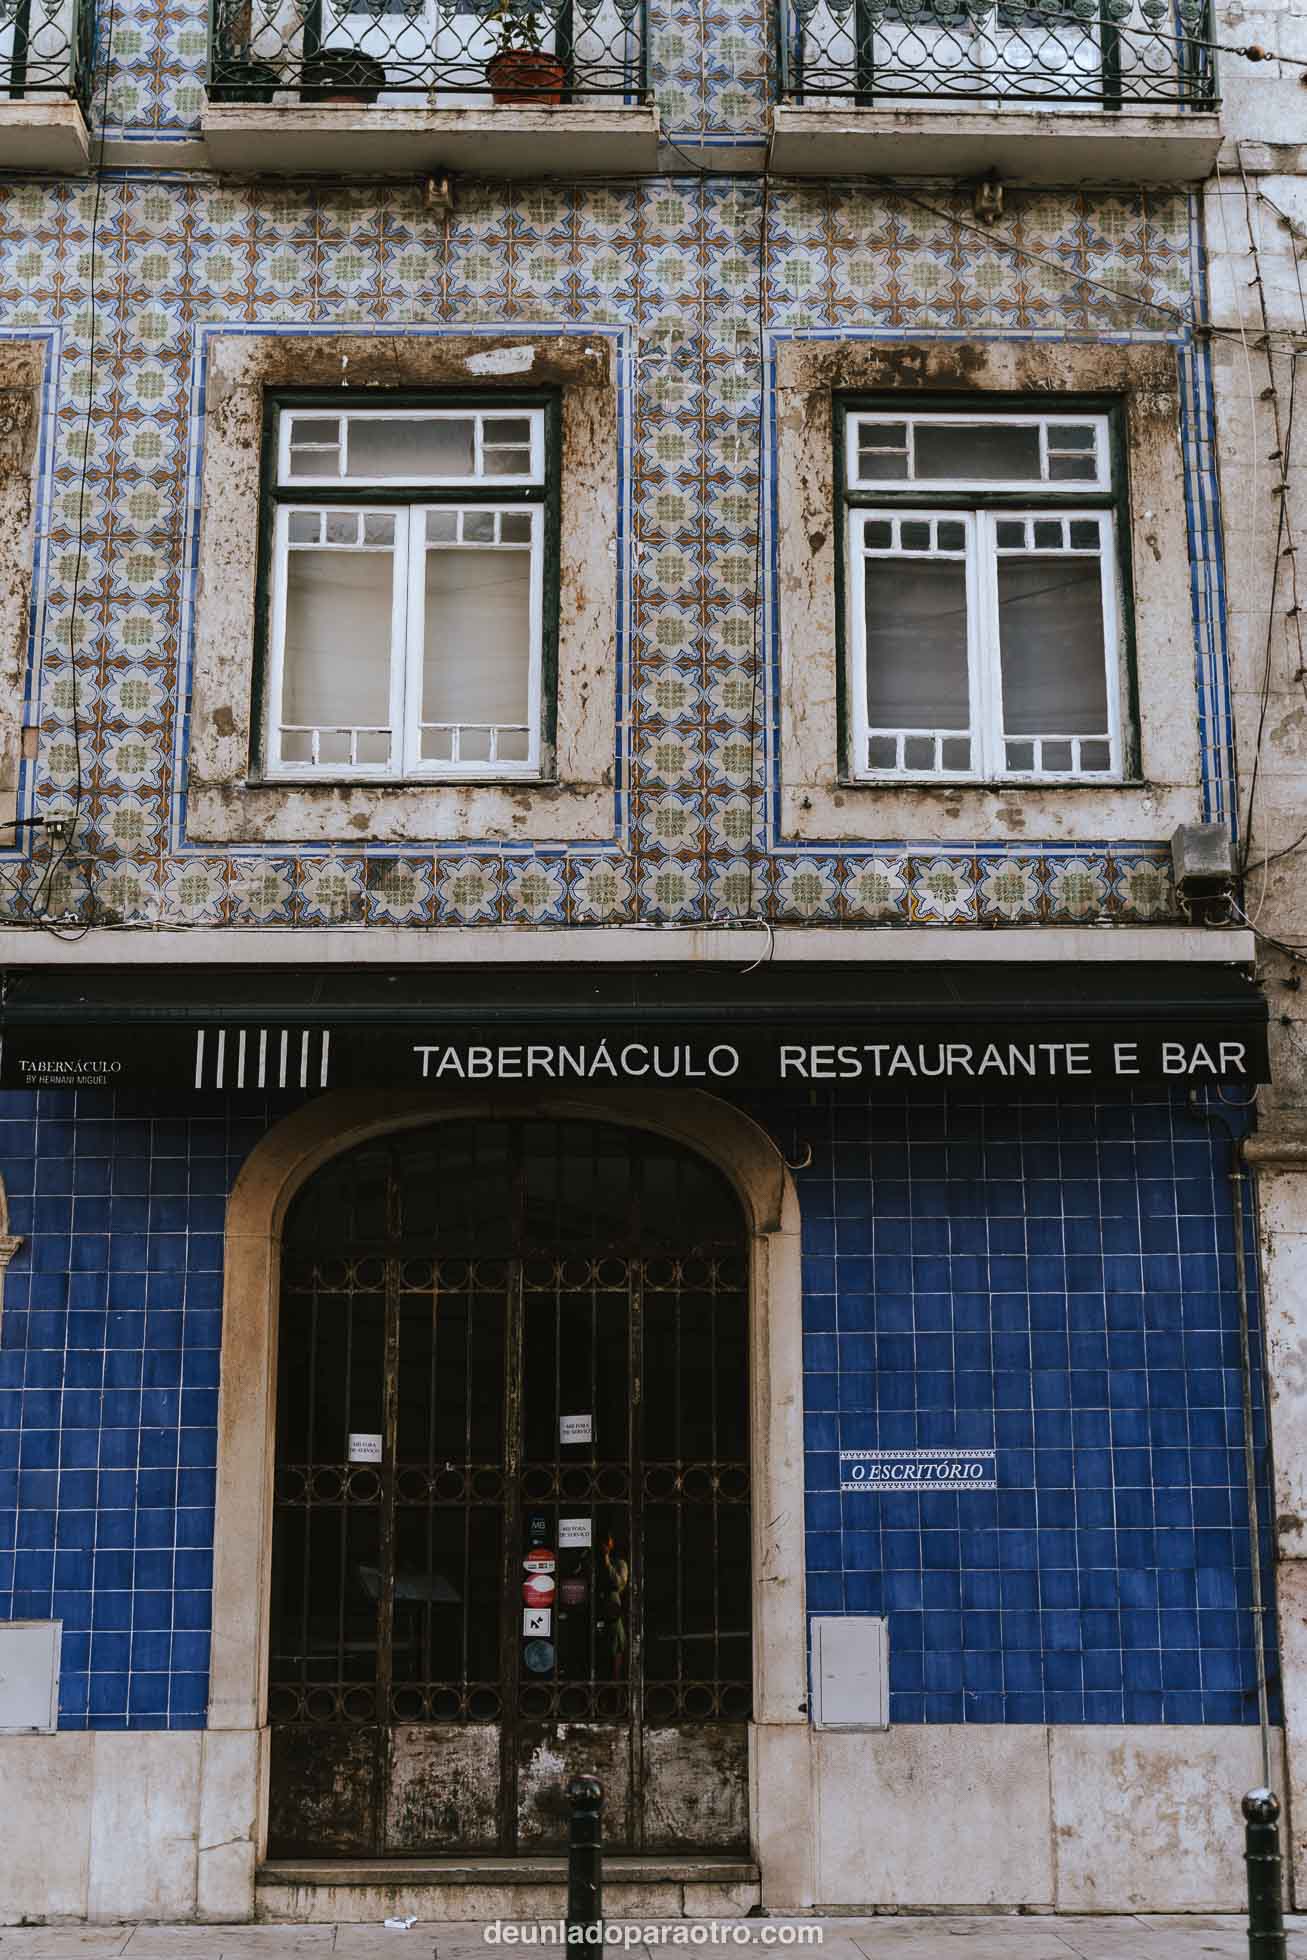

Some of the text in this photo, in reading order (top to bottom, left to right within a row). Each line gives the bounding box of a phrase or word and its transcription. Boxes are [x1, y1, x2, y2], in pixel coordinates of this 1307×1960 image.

[414, 1039, 1246, 1077] TABERNÁCULO RESTAURANTE E BAR
[19, 1060, 120, 1072] TABERNÁCULO
[26, 1075, 37, 1084] BY
[77, 1075, 107, 1085] MIGUEL
[851, 1461, 984, 1480] O ESCRITÓRIO
